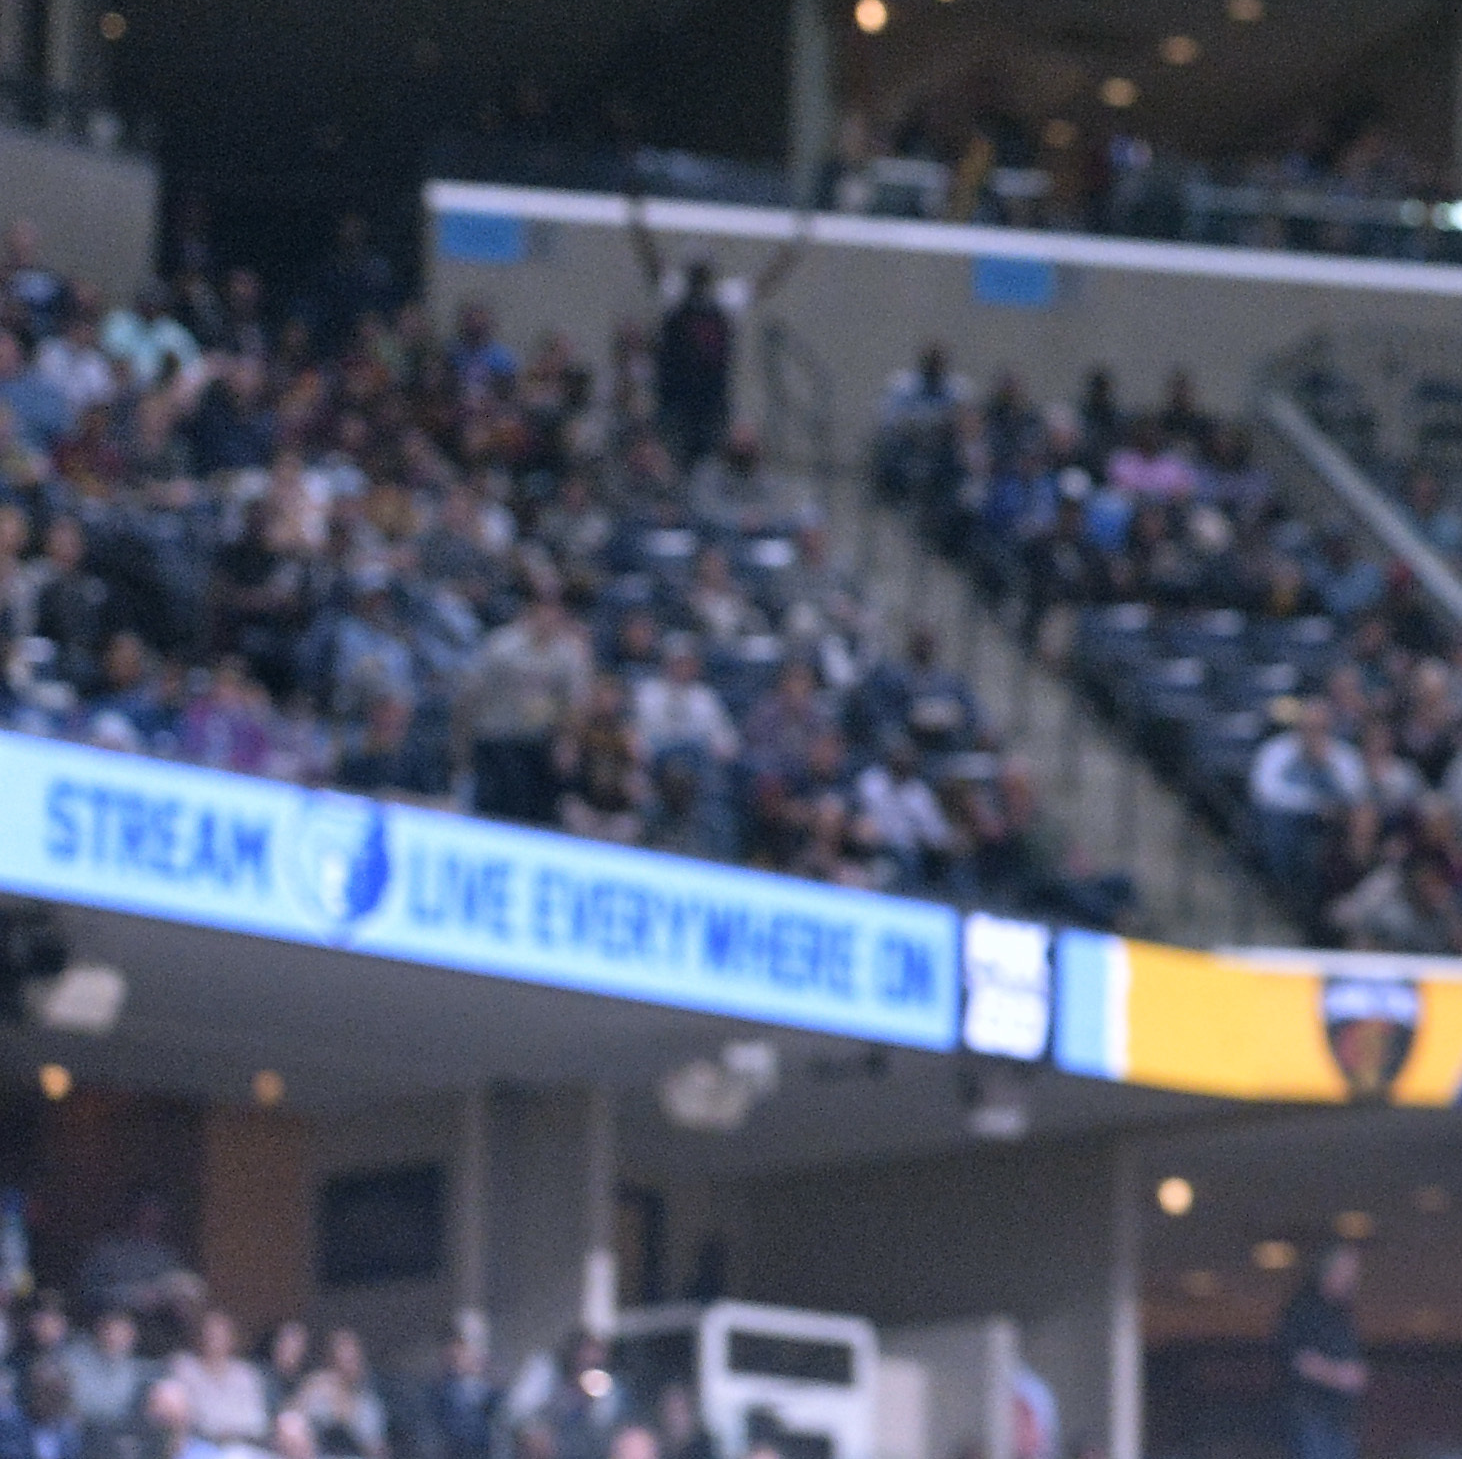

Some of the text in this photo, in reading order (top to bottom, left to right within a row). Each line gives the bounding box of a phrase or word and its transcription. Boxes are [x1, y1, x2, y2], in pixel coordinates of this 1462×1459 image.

[43, 776, 277, 893] STREAM
[404, 844, 512, 941] LIVE
[531, 862, 860, 1004] EVERYWHERE
[877, 924, 937, 1008] ON
